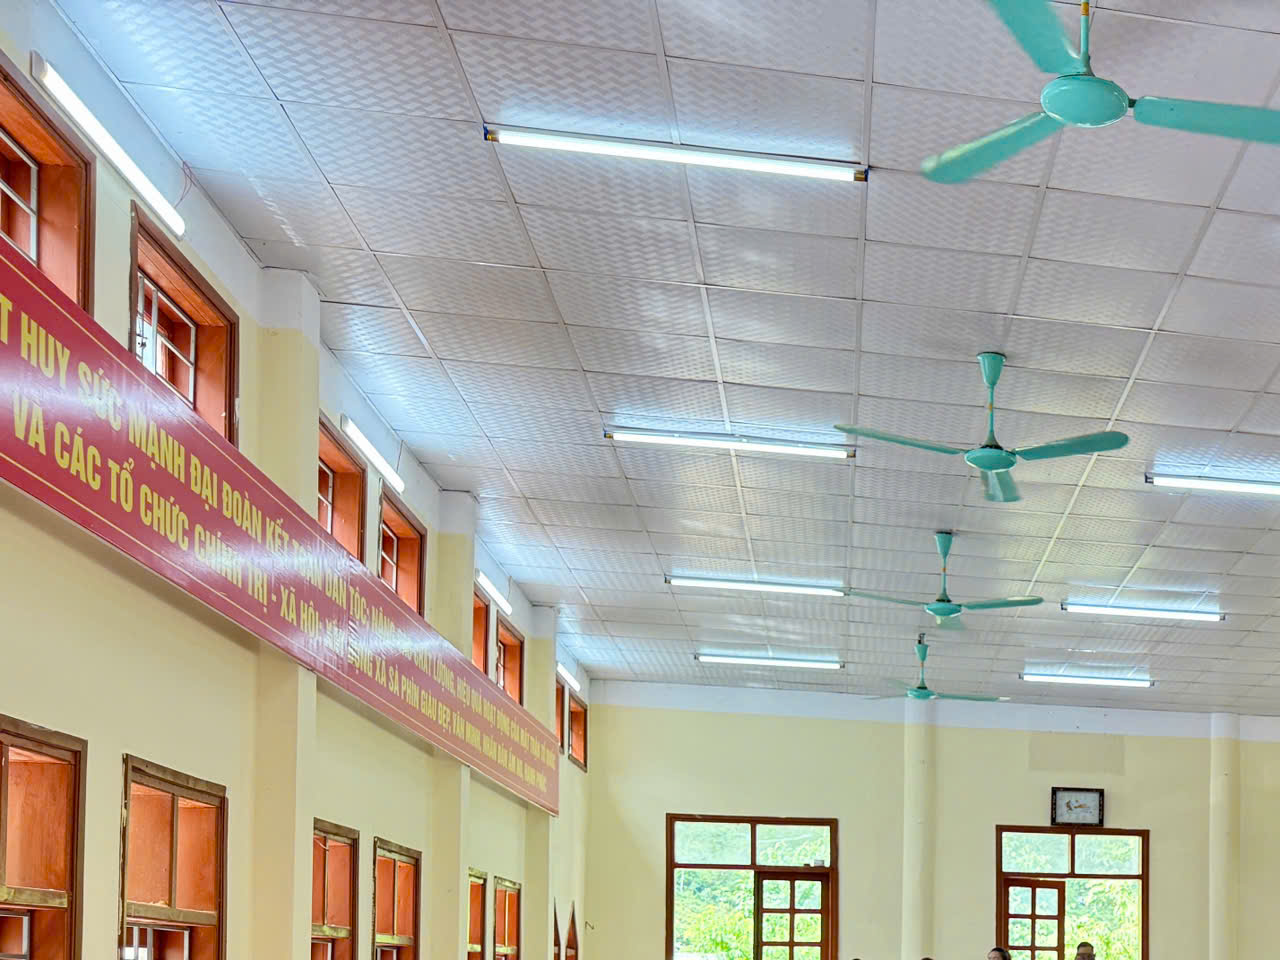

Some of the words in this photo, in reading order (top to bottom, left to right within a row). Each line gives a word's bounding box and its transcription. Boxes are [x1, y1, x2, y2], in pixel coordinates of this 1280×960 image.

[12, 389, 46, 456] VÀ
[54, 421, 101, 490] CÁC
[107, 457, 135, 512] TỔ
[140, 484, 189, 551] CHỨC
[194, 524, 242, 589] CHÍNH
[246, 560, 268, 614] TRỊ
[280, 585, 297, 627] XÃ
[21, 310, 70, 392] HUY
[78, 361, 122, 431] SỨC
[128, 401, 185, 484] MẠNH
[190, 452, 218, 511] ĐẠI
[222, 480, 262, 544] ĐOÀN
[265, 515, 289, 560] KẾT
